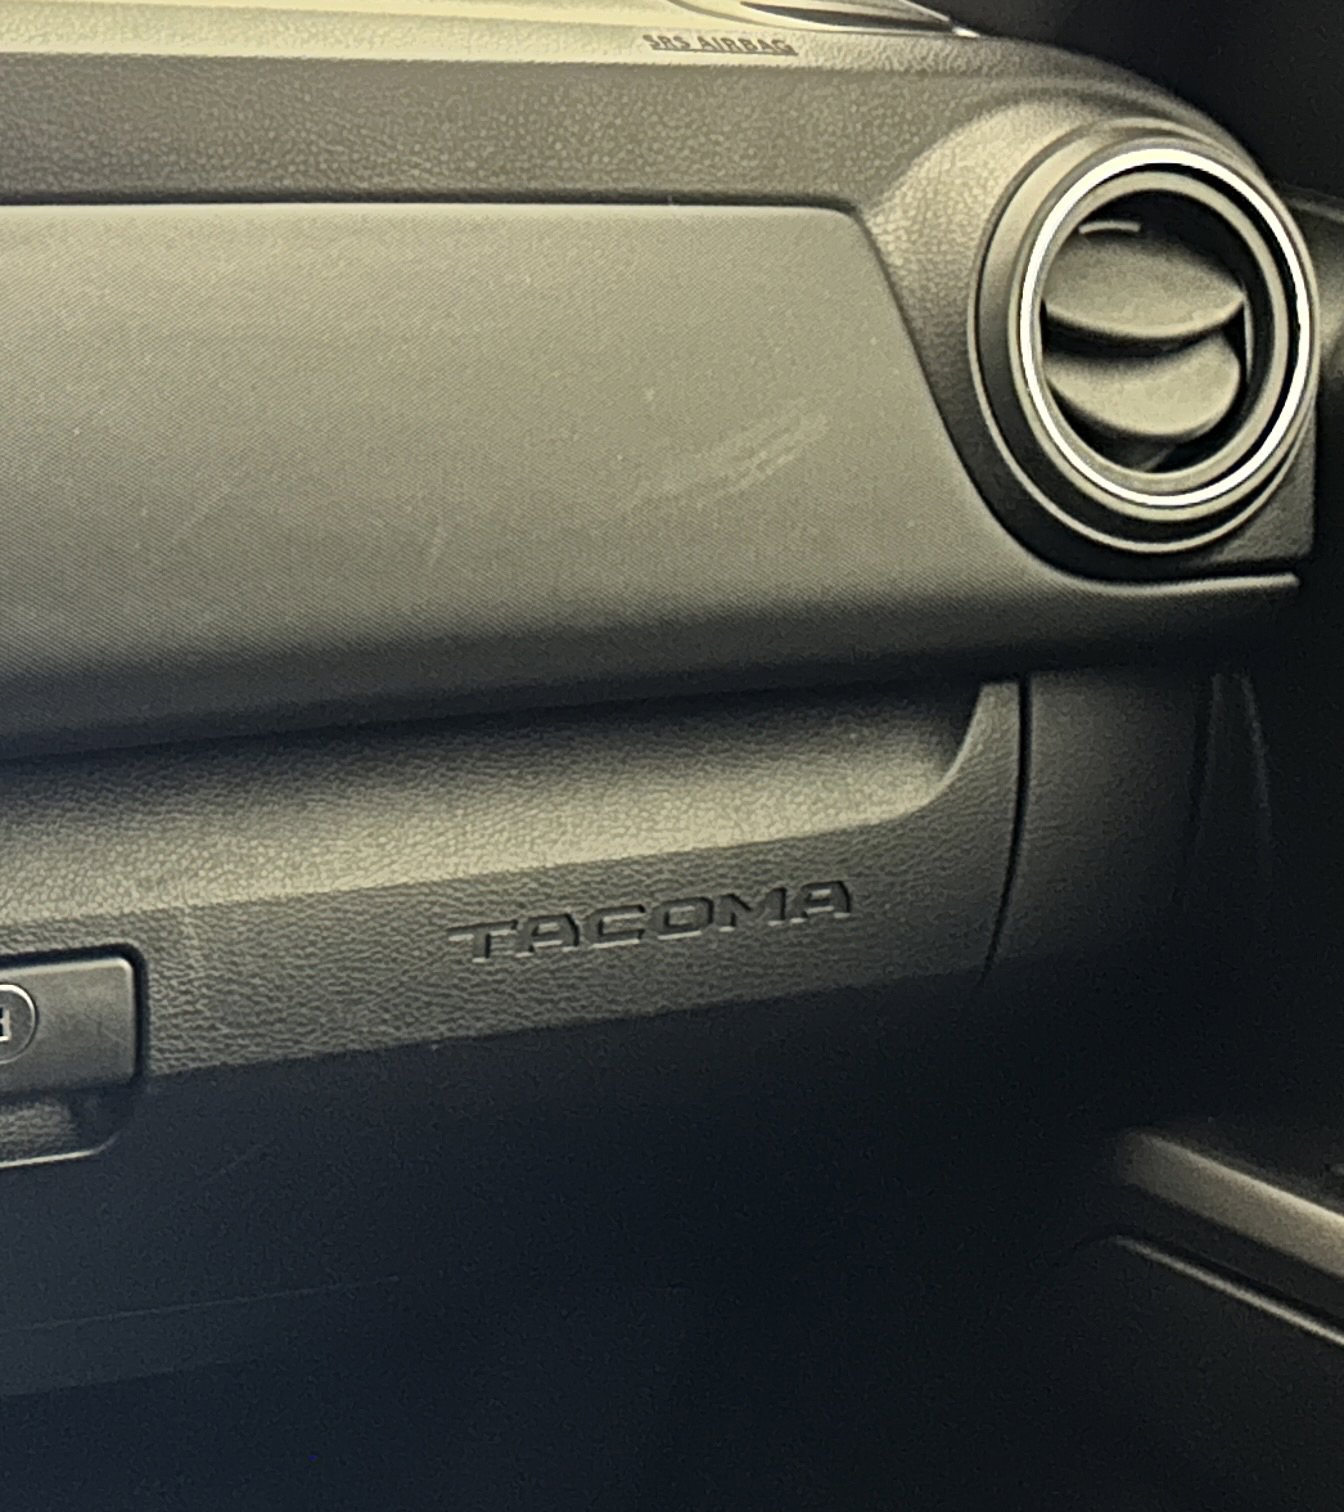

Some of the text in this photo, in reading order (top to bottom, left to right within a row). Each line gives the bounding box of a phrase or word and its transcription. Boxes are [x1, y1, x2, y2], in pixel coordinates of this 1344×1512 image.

[643, 34, 796, 55] SRS AIRBAG
[445, 880, 852, 963] TACOMA
